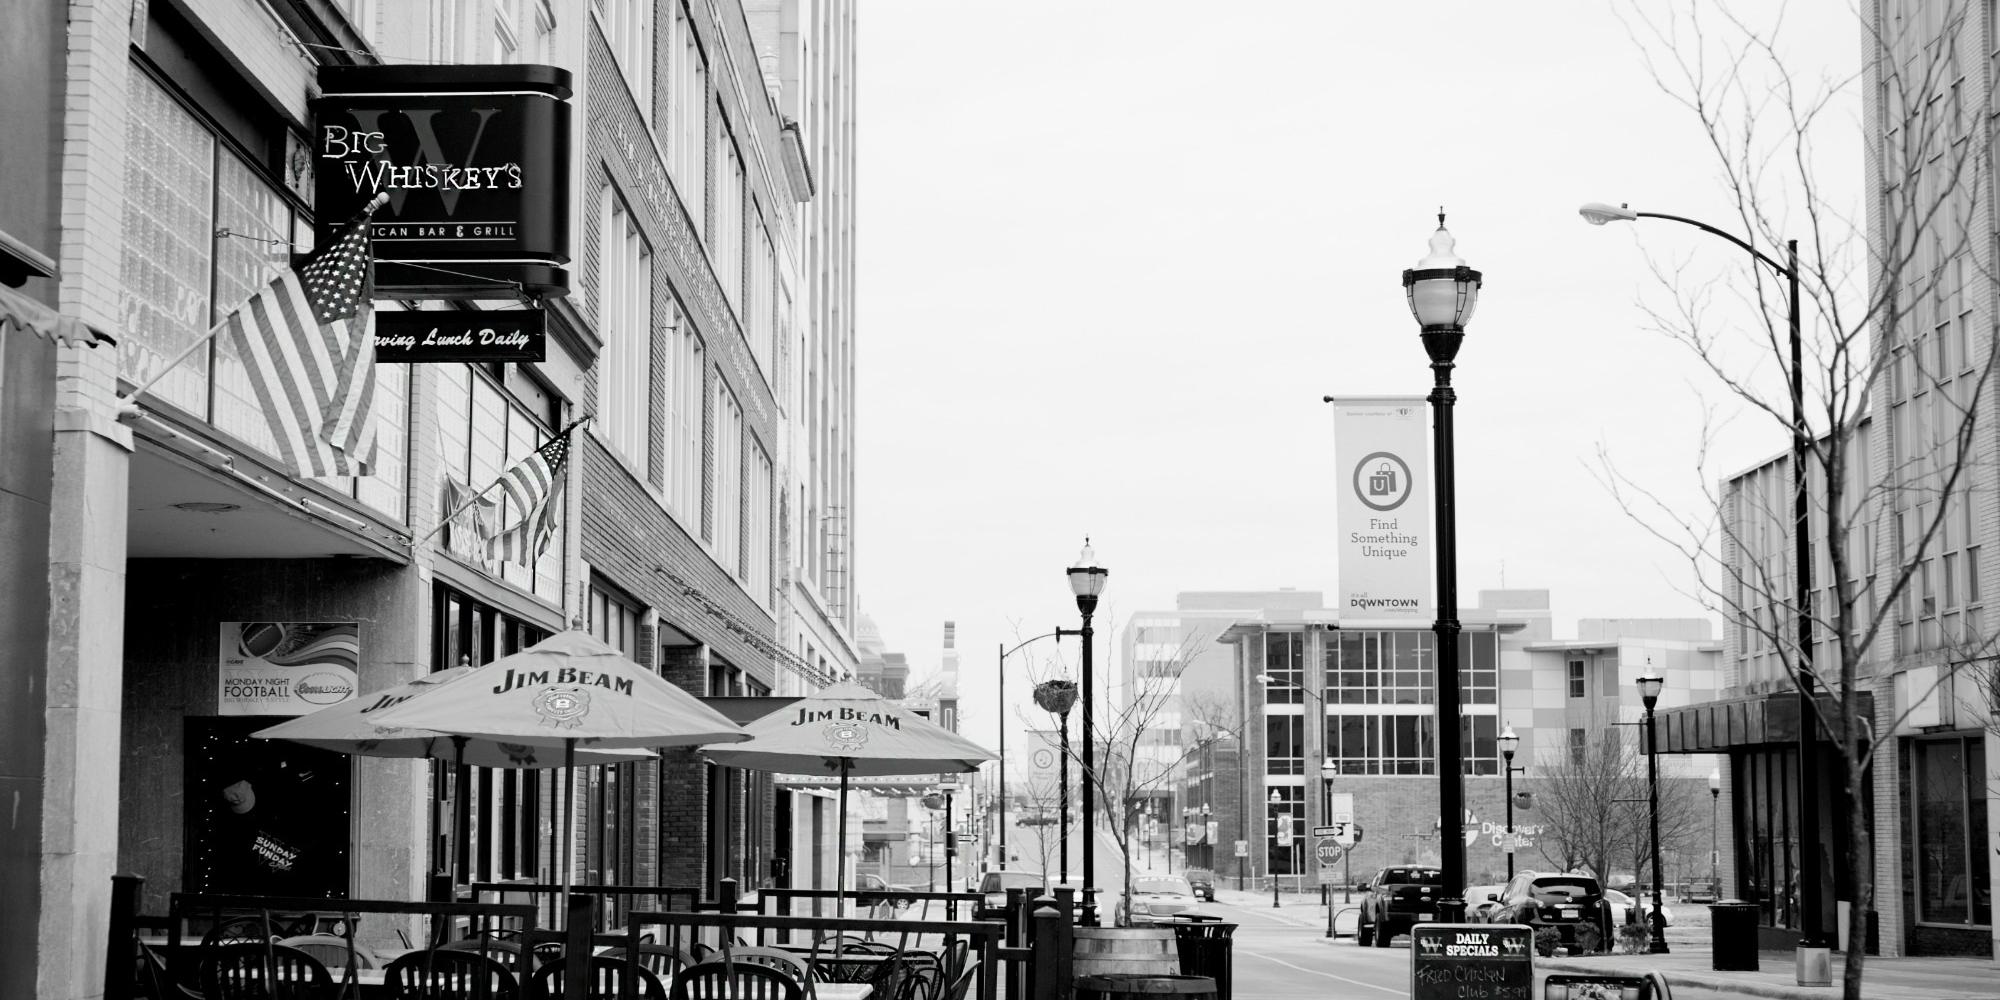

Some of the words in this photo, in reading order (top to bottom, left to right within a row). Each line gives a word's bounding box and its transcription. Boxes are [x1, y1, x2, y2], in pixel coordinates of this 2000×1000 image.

[322, 125, 388, 158] BIG
[372, 227, 408, 237] ICAN
[419, 227, 445, 237] BAR
[474, 226, 514, 237] GRILL
[374, 333, 416, 351] rving
[421, 327, 474, 346] Lunch
[478, 328, 530, 350] Daily
[1370, 518, 1398, 530] Find
[1351, 532, 1418, 546] Something
[1362, 546, 1408, 560] Unique
[1350, 599, 1418, 609] DOWNTOWN
[225, 678, 262, 686] MONDAY
[265, 678, 290, 686] NIGHT
[493, 669, 549, 694] JIM
[558, 667, 634, 696] BEAM
[224, 686, 290, 697] FOOTBALL
[791, 707, 833, 726] JIM
[840, 707, 900, 730] BEAM
[256, 836, 297, 860] SUNDAY
[1318, 846, 1341, 857] STOP
[252, 843, 293, 867] FUNDAY
[1456, 933, 1490, 945] DAILY
[1446, 945, 1499, 957] SPECIALS
[1458, 985, 1489, 998] Club
